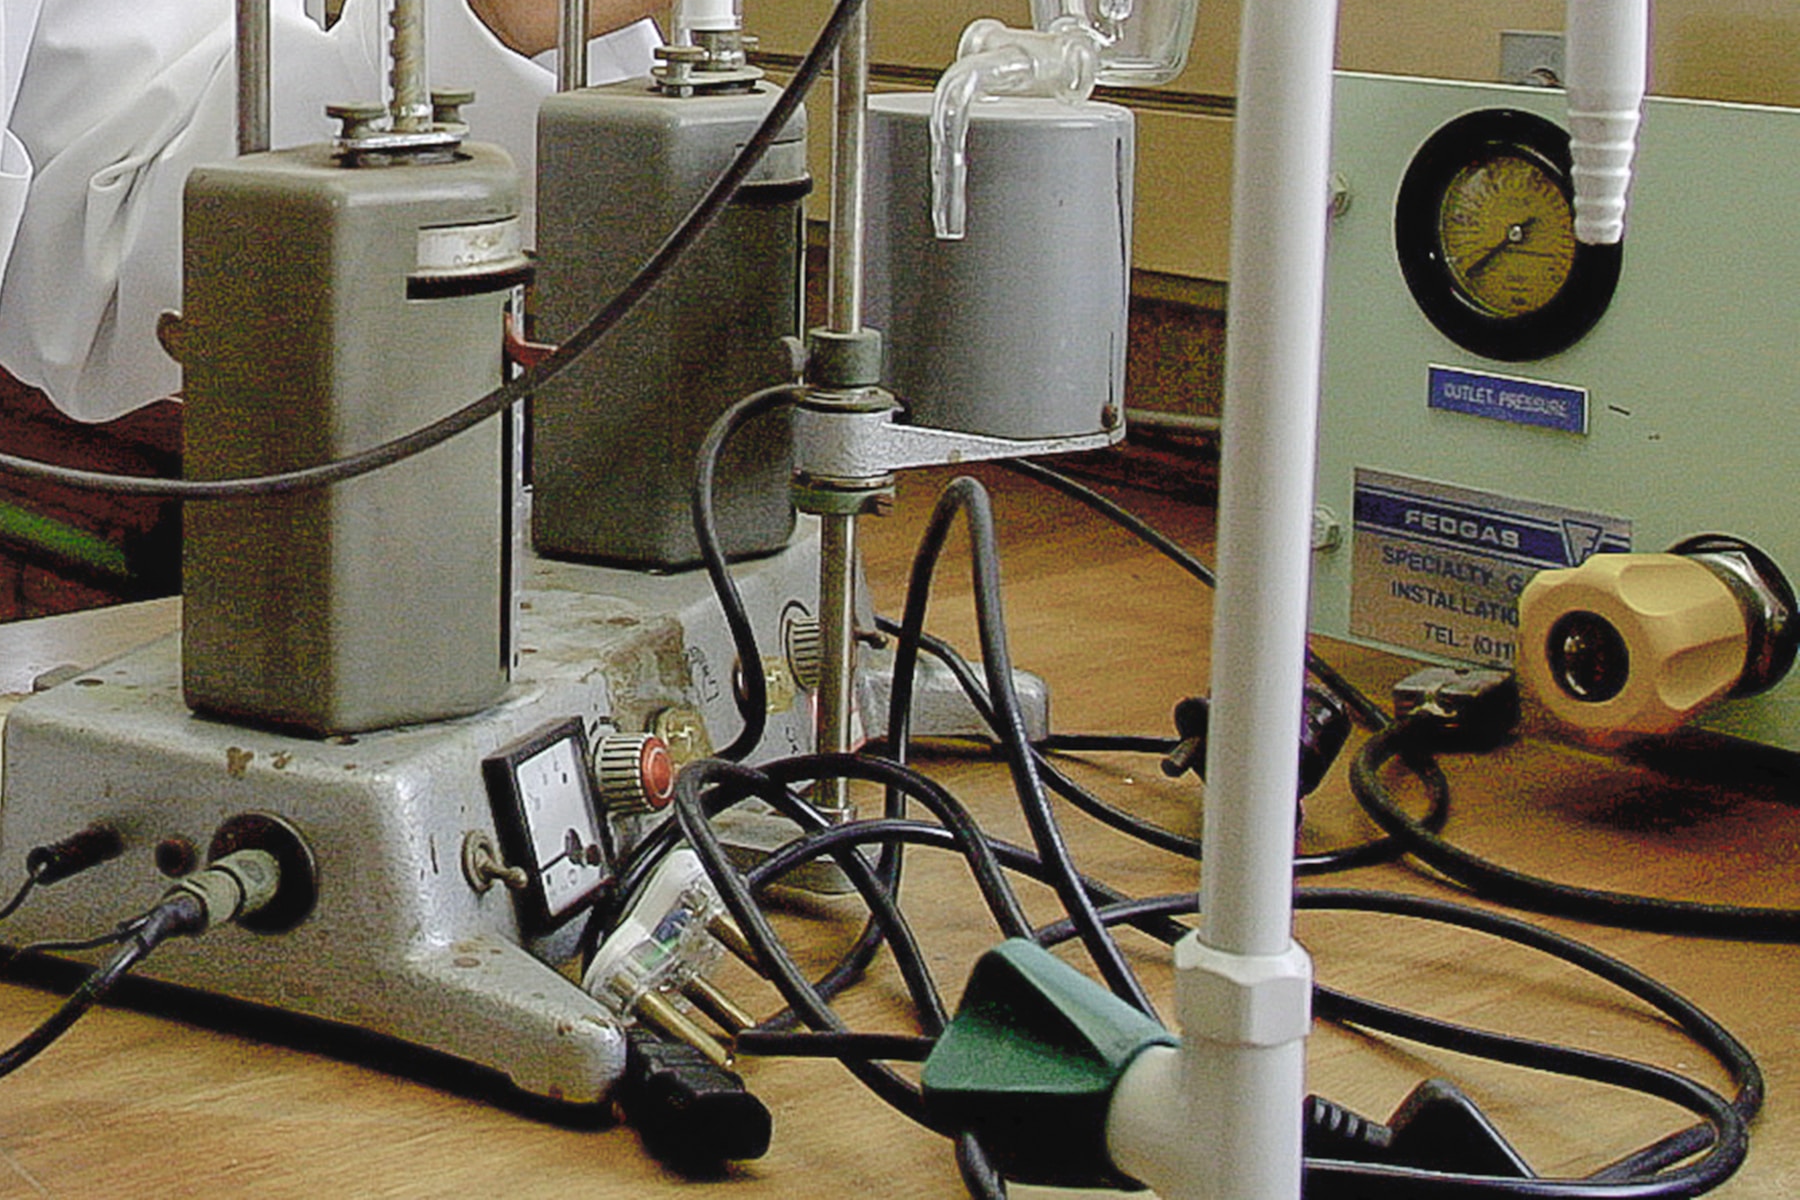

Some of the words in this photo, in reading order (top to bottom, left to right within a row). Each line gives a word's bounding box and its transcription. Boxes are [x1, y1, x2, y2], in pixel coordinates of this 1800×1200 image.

[1443, 383, 1495, 405] OUTLET
[1404, 509, 1521, 550] FEDGAS
[1382, 545, 1494, 586] SPECIALTY
[1391, 580, 1520, 627] INSTALLATIO
